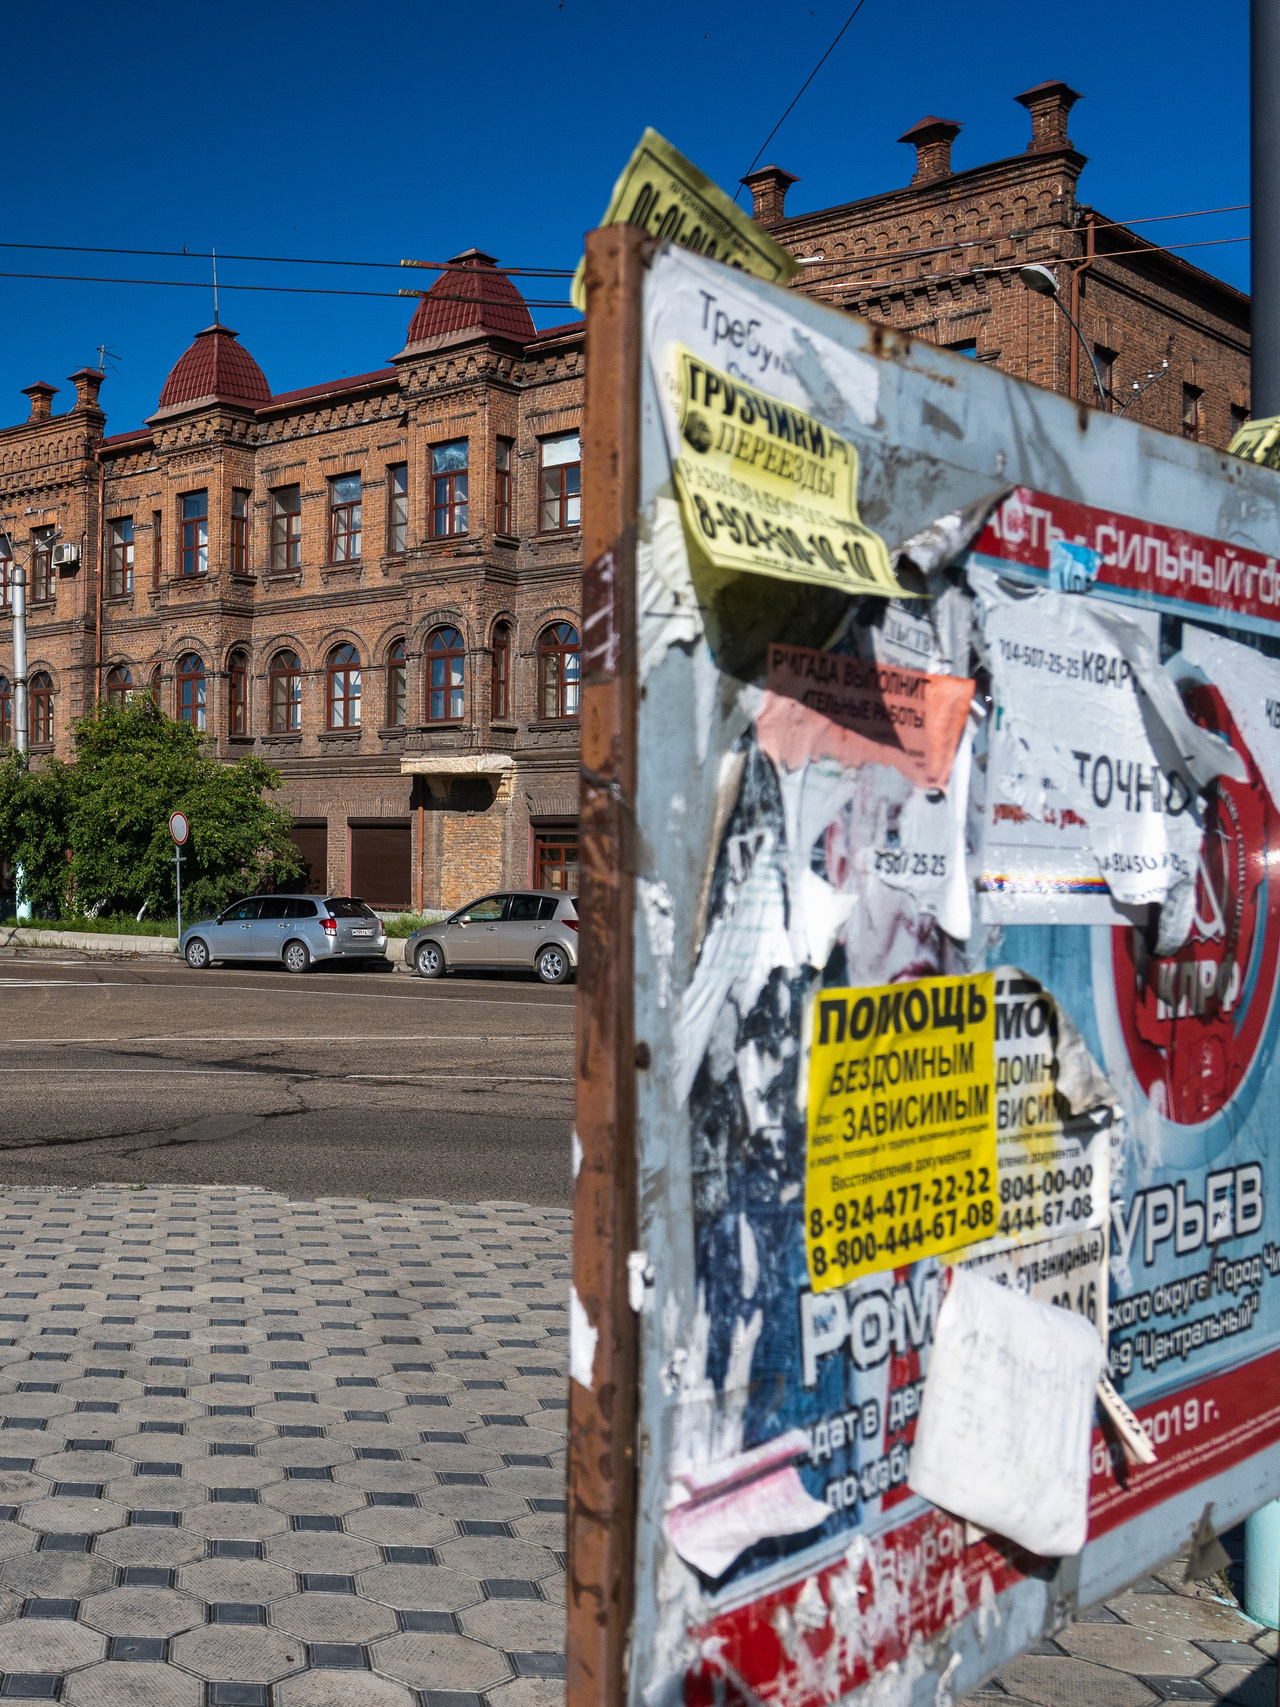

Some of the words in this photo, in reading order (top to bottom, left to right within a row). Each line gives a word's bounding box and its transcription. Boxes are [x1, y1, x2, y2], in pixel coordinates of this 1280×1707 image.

[688, 363, 827, 459] ГРУЗЧИКИ
[716, 420, 837, 498] ПЕРЕЕЗДЫ
[1095, 523, 1241, 597] СИЛЬНЫЙ
[818, 983, 988, 1046] ПОМОЩЬ
[829, 1041, 976, 1098] БЕЗДОМНЫМ
[842, 1084, 990, 1143] ЗАВИСИМЫМ
[810, 1167, 991, 1239] 8-924-477-22-22
[997, 1194, 1094, 1236] 444-67-08
[1000, 1163, 1094, 1205] 804-00-00
[812, 1199, 994, 1277] 8-800-444-67-08
[862, 1399, 881, 1439] в
